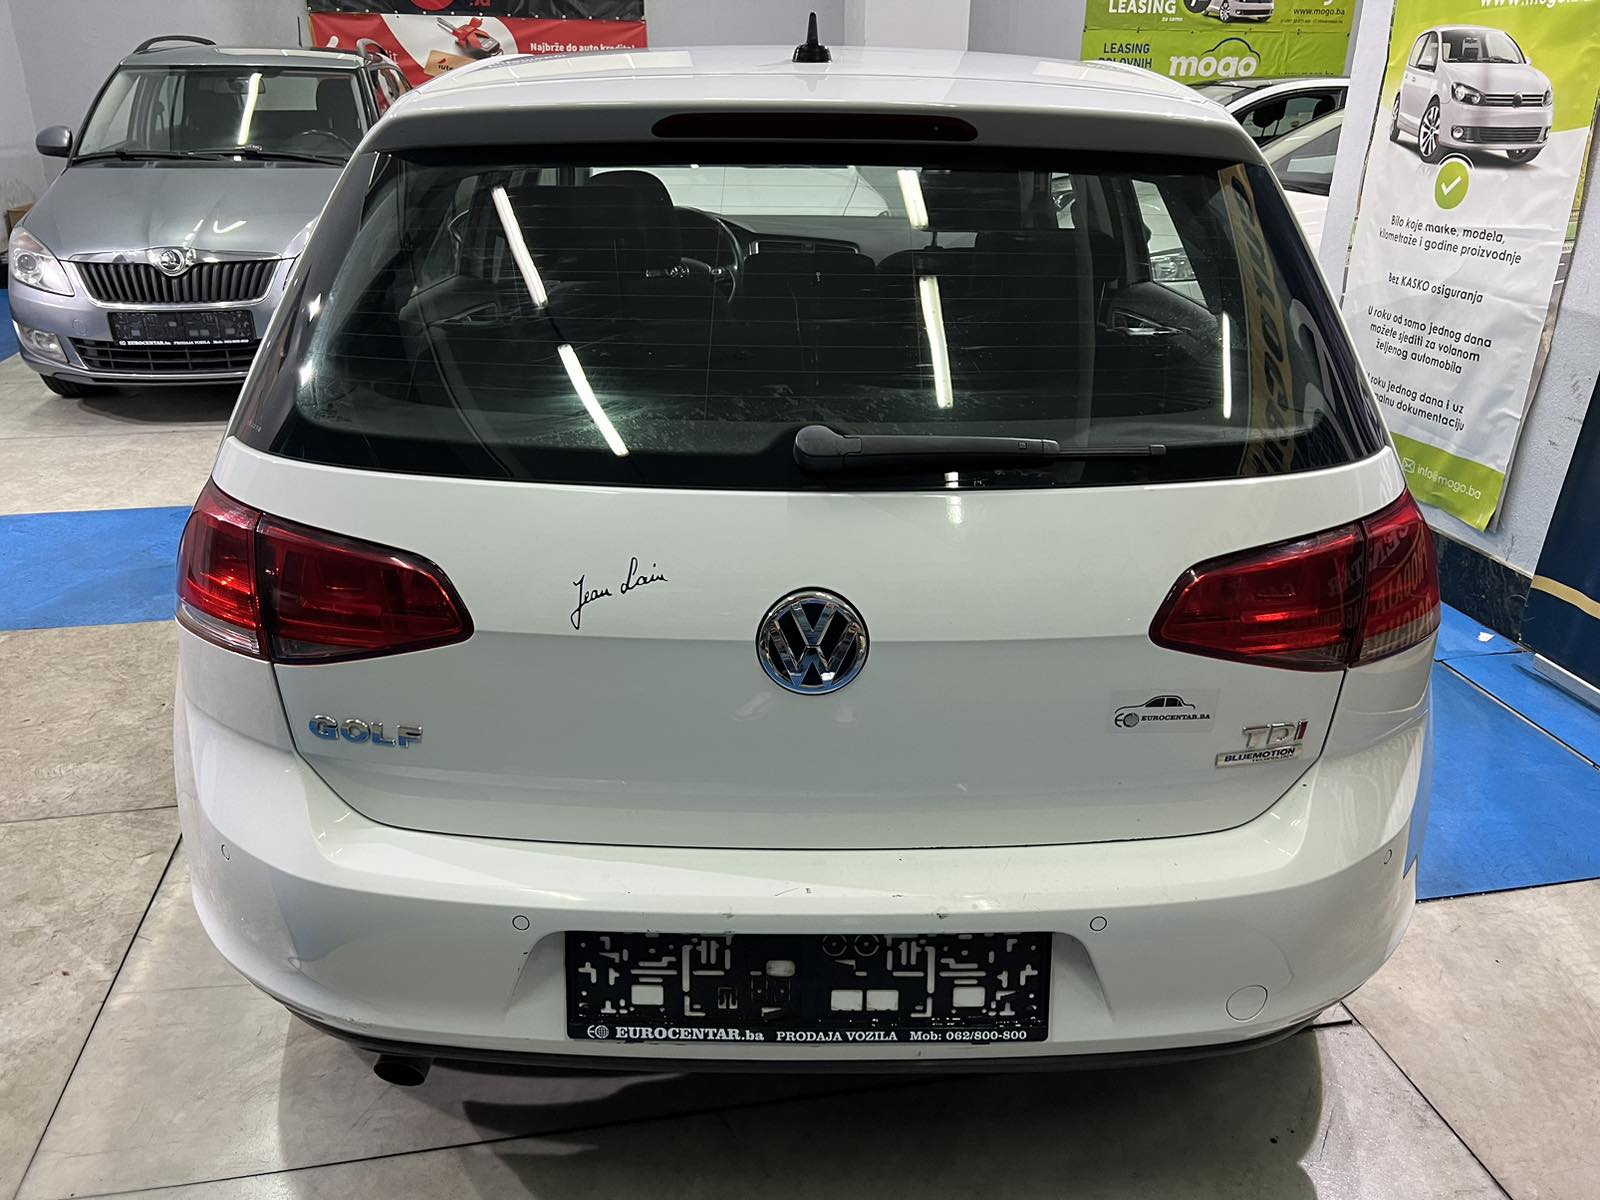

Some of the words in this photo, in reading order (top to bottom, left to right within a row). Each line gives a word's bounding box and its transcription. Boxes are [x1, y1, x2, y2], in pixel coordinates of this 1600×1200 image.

[1108, 0, 1177, 14] LEASING
[1293, 8, 1345, 17] www.mogo.ba
[530, 42, 564, 53] Najbrže
[566, 43, 578, 52] do
[1103, 43, 1151, 54] LEASING
[1391, 215, 1404, 227] Bilo
[1405, 218, 1423, 232] koje
[1425, 224, 1459, 237] marke,
[1462, 228, 1505, 245] modela,
[1419, 236, 1423, 247] i
[1424, 239, 1459, 253] godine
[1460, 245, 1522, 265] proizvodnje
[1388, 272, 1399, 284] Bez
[1401, 276, 1430, 291] KASKO
[1431, 282, 1484, 304] osiguranja
[1368, 305, 1374, 316] U
[1374, 309, 1392, 321] roku
[1393, 314, 1403, 325] od
[1428, 322, 1462, 343] jednog
[1463, 332, 1492, 348] dana
[1398, 331, 1424, 347] sjediti
[1425, 340, 1436, 350] za
[1438, 343, 1480, 362] volanom
[1410, 352, 1463, 374] automobila
[1370, 376, 1387, 389] roku
[1386, 380, 1418, 402] jednog
[1419, 392, 1444, 409] dana
[1445, 399, 1450, 410] i
[1452, 403, 1465, 415] uz
[1396, 400, 1465, 432] dokumentaciju
[1416, 464, 1482, 500] info@mogo.ba
[570, 574, 613, 630] Jean
[762, 594, 864, 690] VW
[308, 714, 424, 749] GOLF
[1224, 747, 1296, 762] BLUEMOTION
[615, 1026, 765, 1041] EUROCENTAR.ba
[776, 1031, 843, 1042] PRODAJA
[846, 1031, 898, 1041] VOZILA
[910, 1031, 942, 1041] Mob:
[946, 1030, 1027, 1041] 062/800-800
